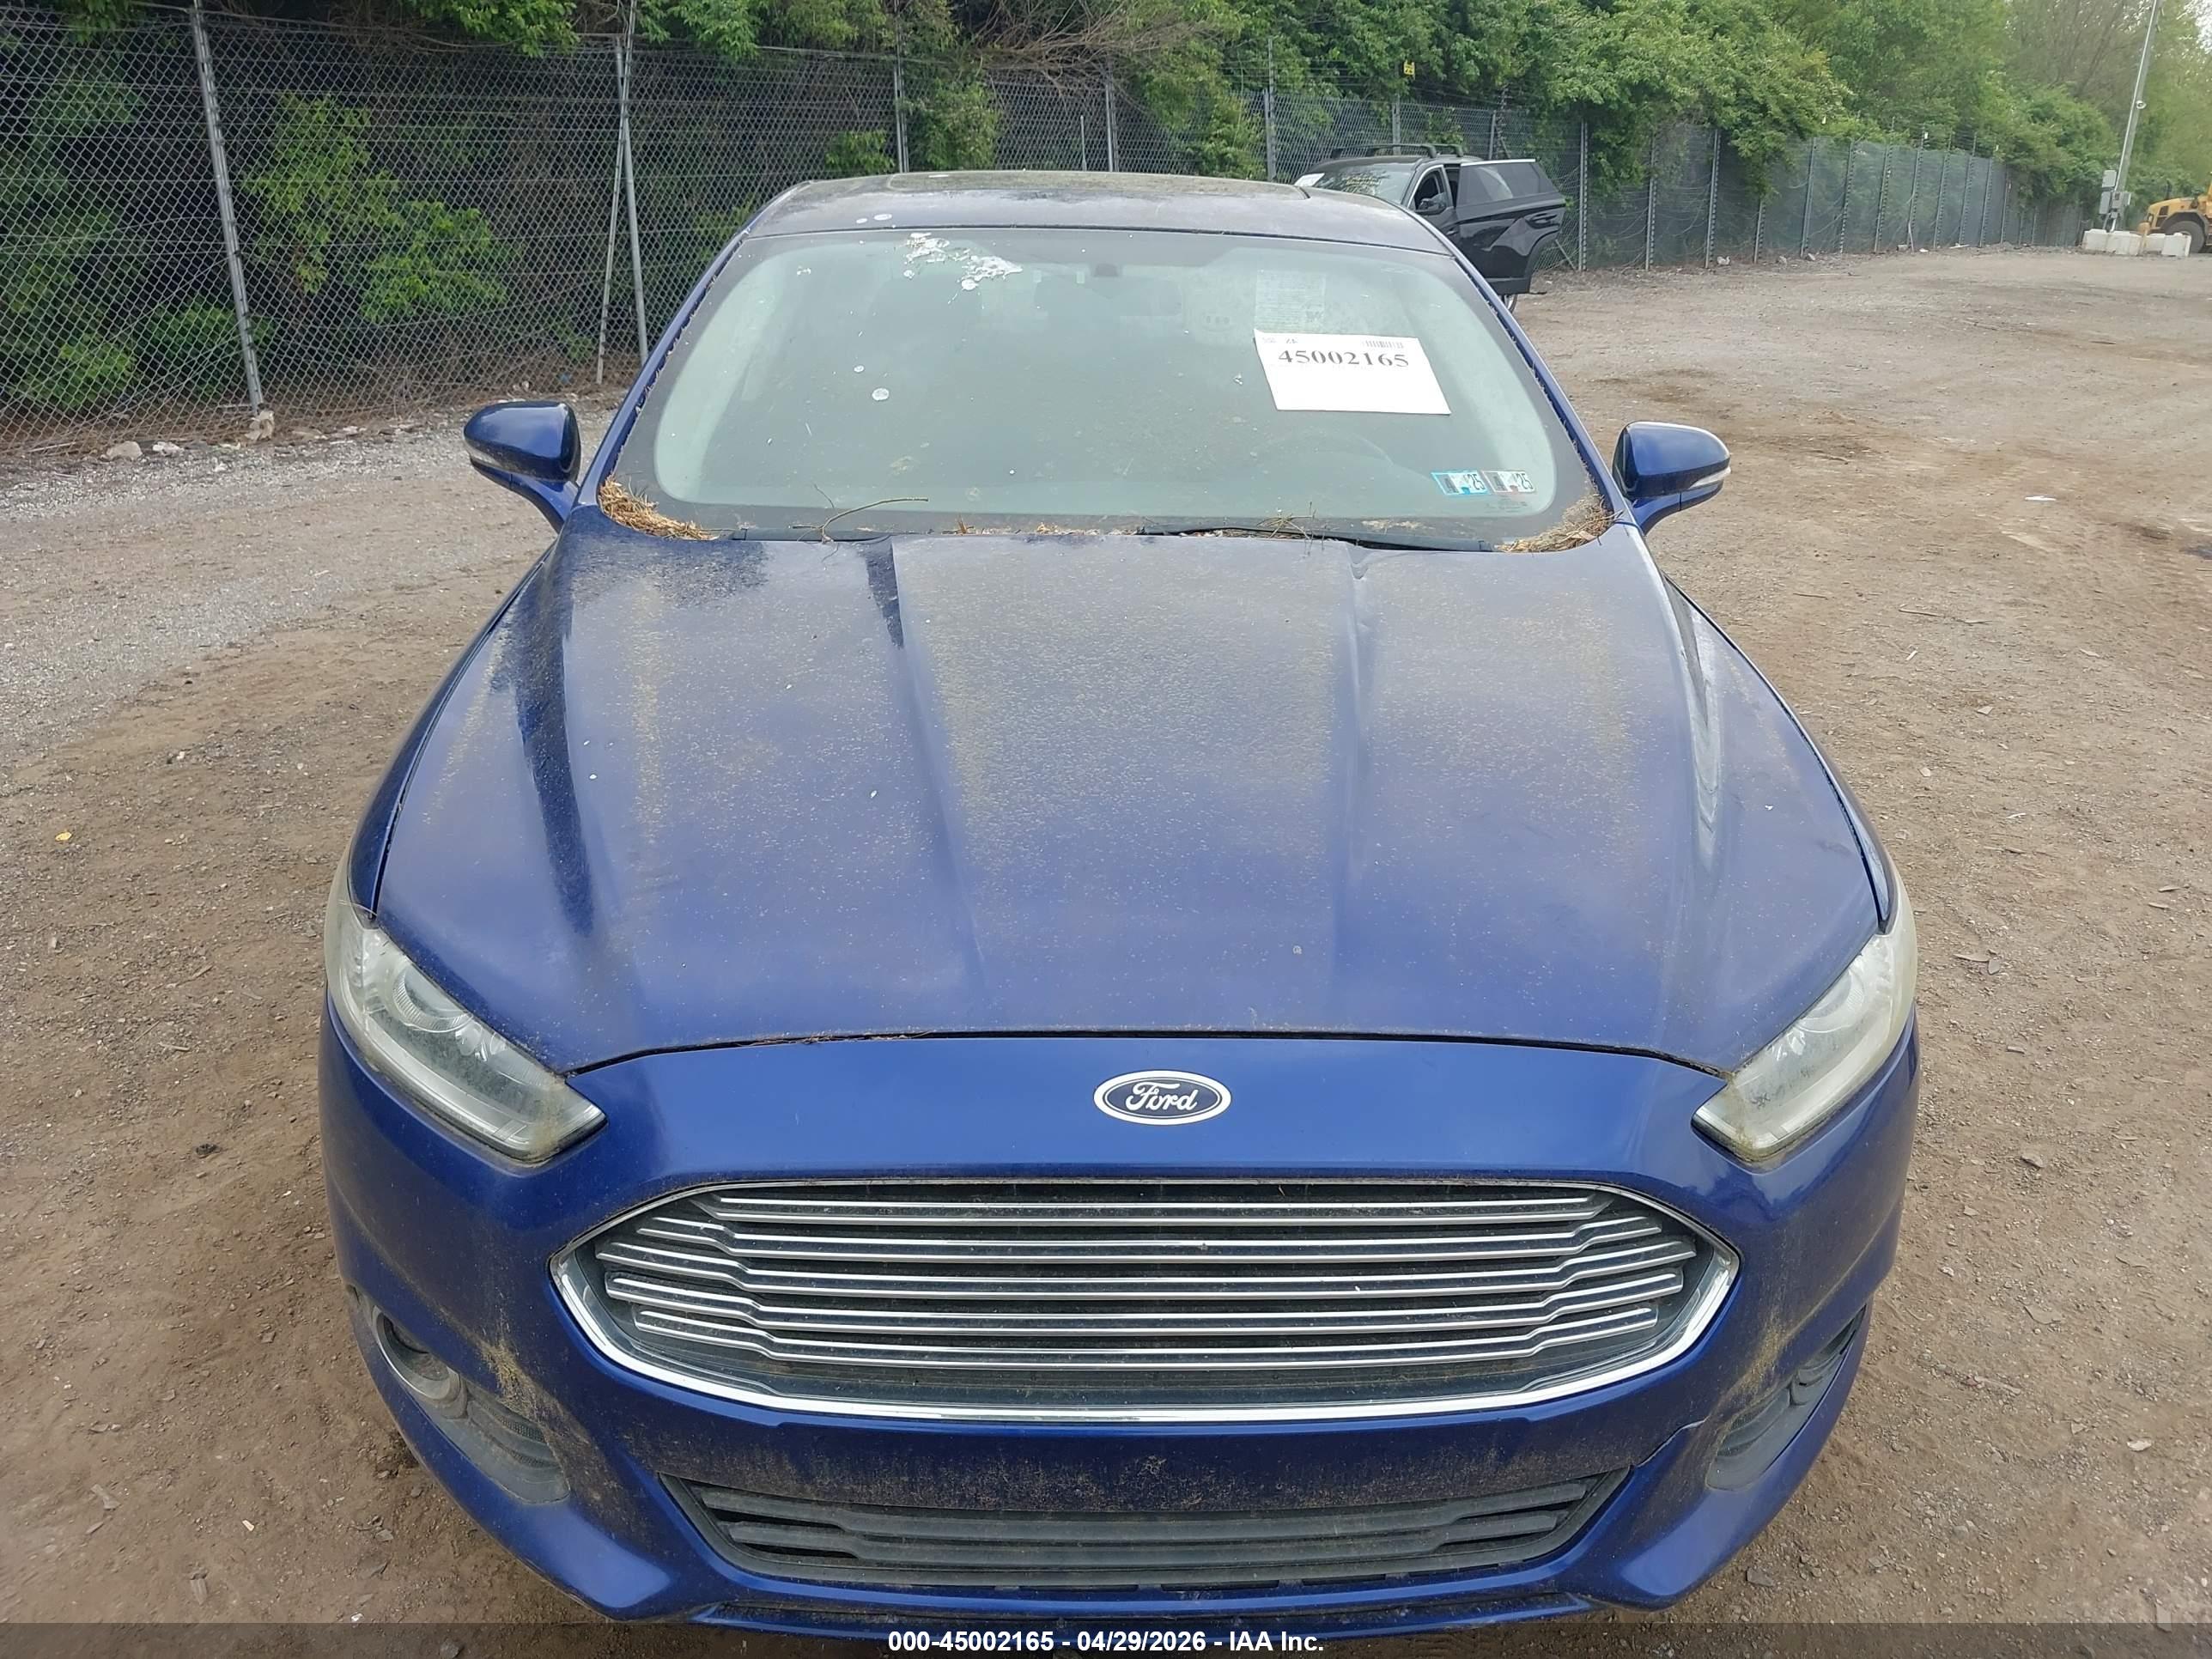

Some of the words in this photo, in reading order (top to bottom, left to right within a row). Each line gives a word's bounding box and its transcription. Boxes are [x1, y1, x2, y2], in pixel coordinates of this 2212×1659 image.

[1278, 349, 1409, 368] 45002165
[1466, 473, 1486, 490] 25
[1515, 472, 1534, 489] 25
[1125, 1081, 1199, 1111] Ford
